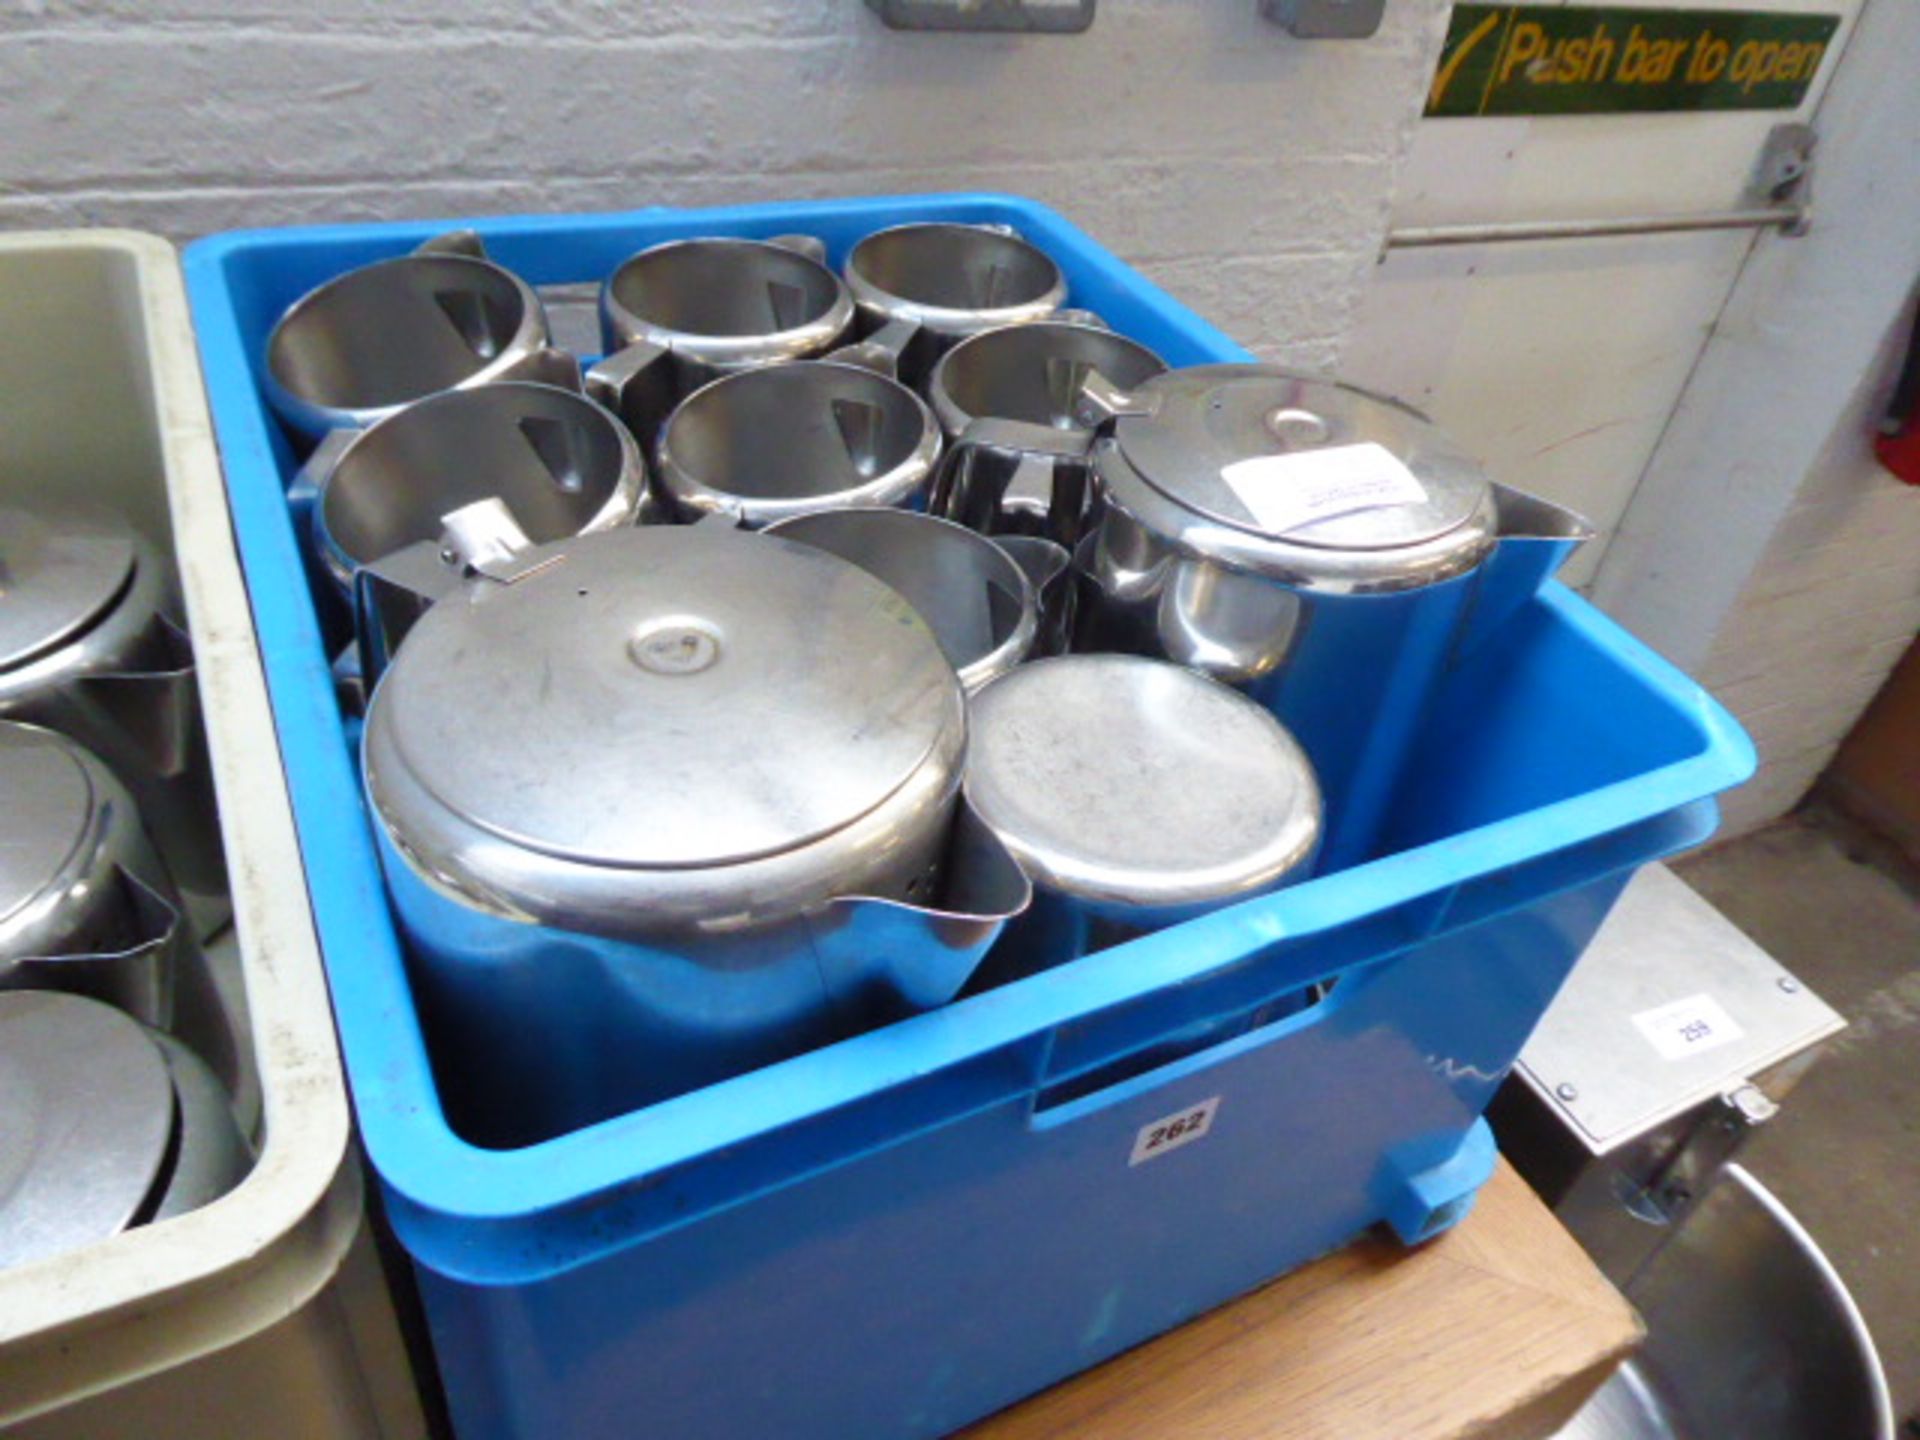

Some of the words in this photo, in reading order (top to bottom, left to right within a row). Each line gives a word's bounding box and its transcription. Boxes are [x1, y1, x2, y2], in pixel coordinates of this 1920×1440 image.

[1502, 22, 1615, 83] Push
[1614, 24, 1689, 83] bar
[1686, 29, 1729, 83] to
[1729, 40, 1824, 94] open
[1145, 1110, 1206, 1150] 262
